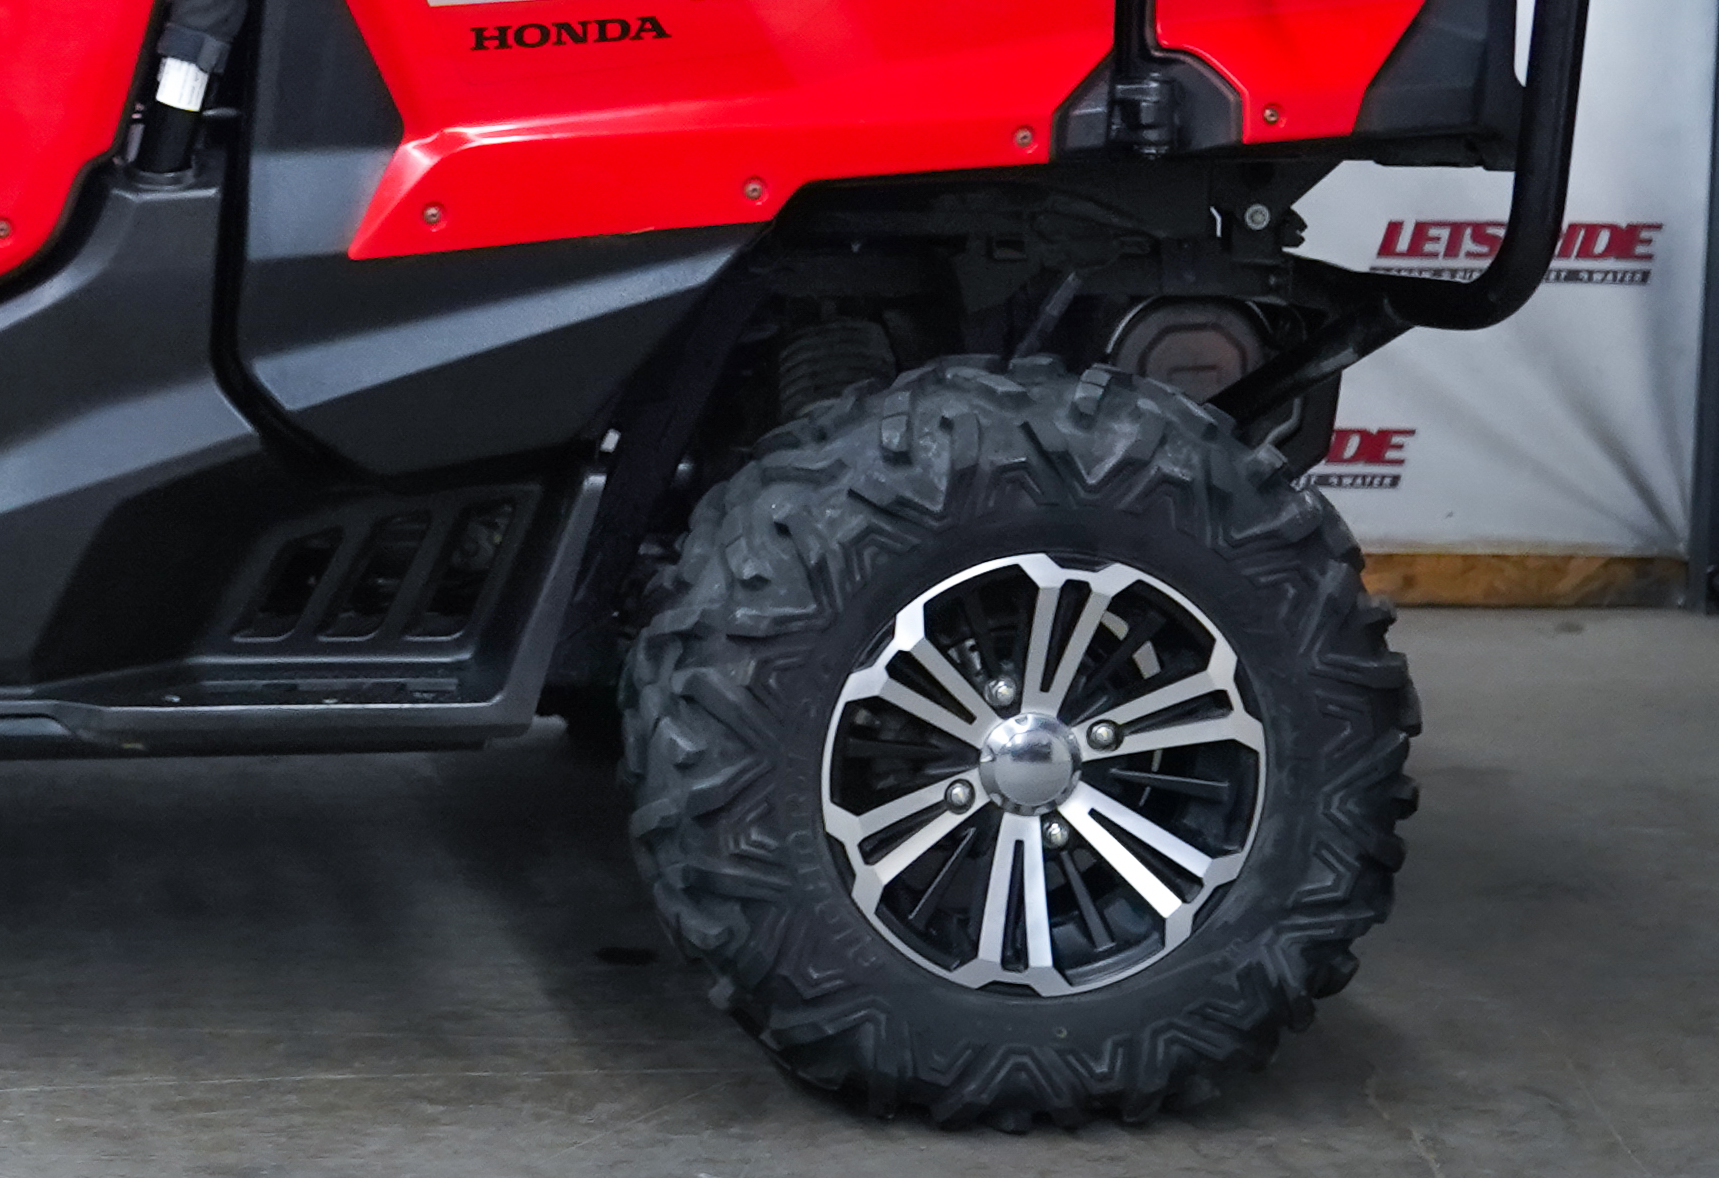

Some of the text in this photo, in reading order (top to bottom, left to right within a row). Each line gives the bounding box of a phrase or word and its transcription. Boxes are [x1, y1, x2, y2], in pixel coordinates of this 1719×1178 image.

[469, 15, 672, 52] HONDA
[1379, 220, 1663, 259] LETS IDE
[1324, 428, 1416, 465] DE
